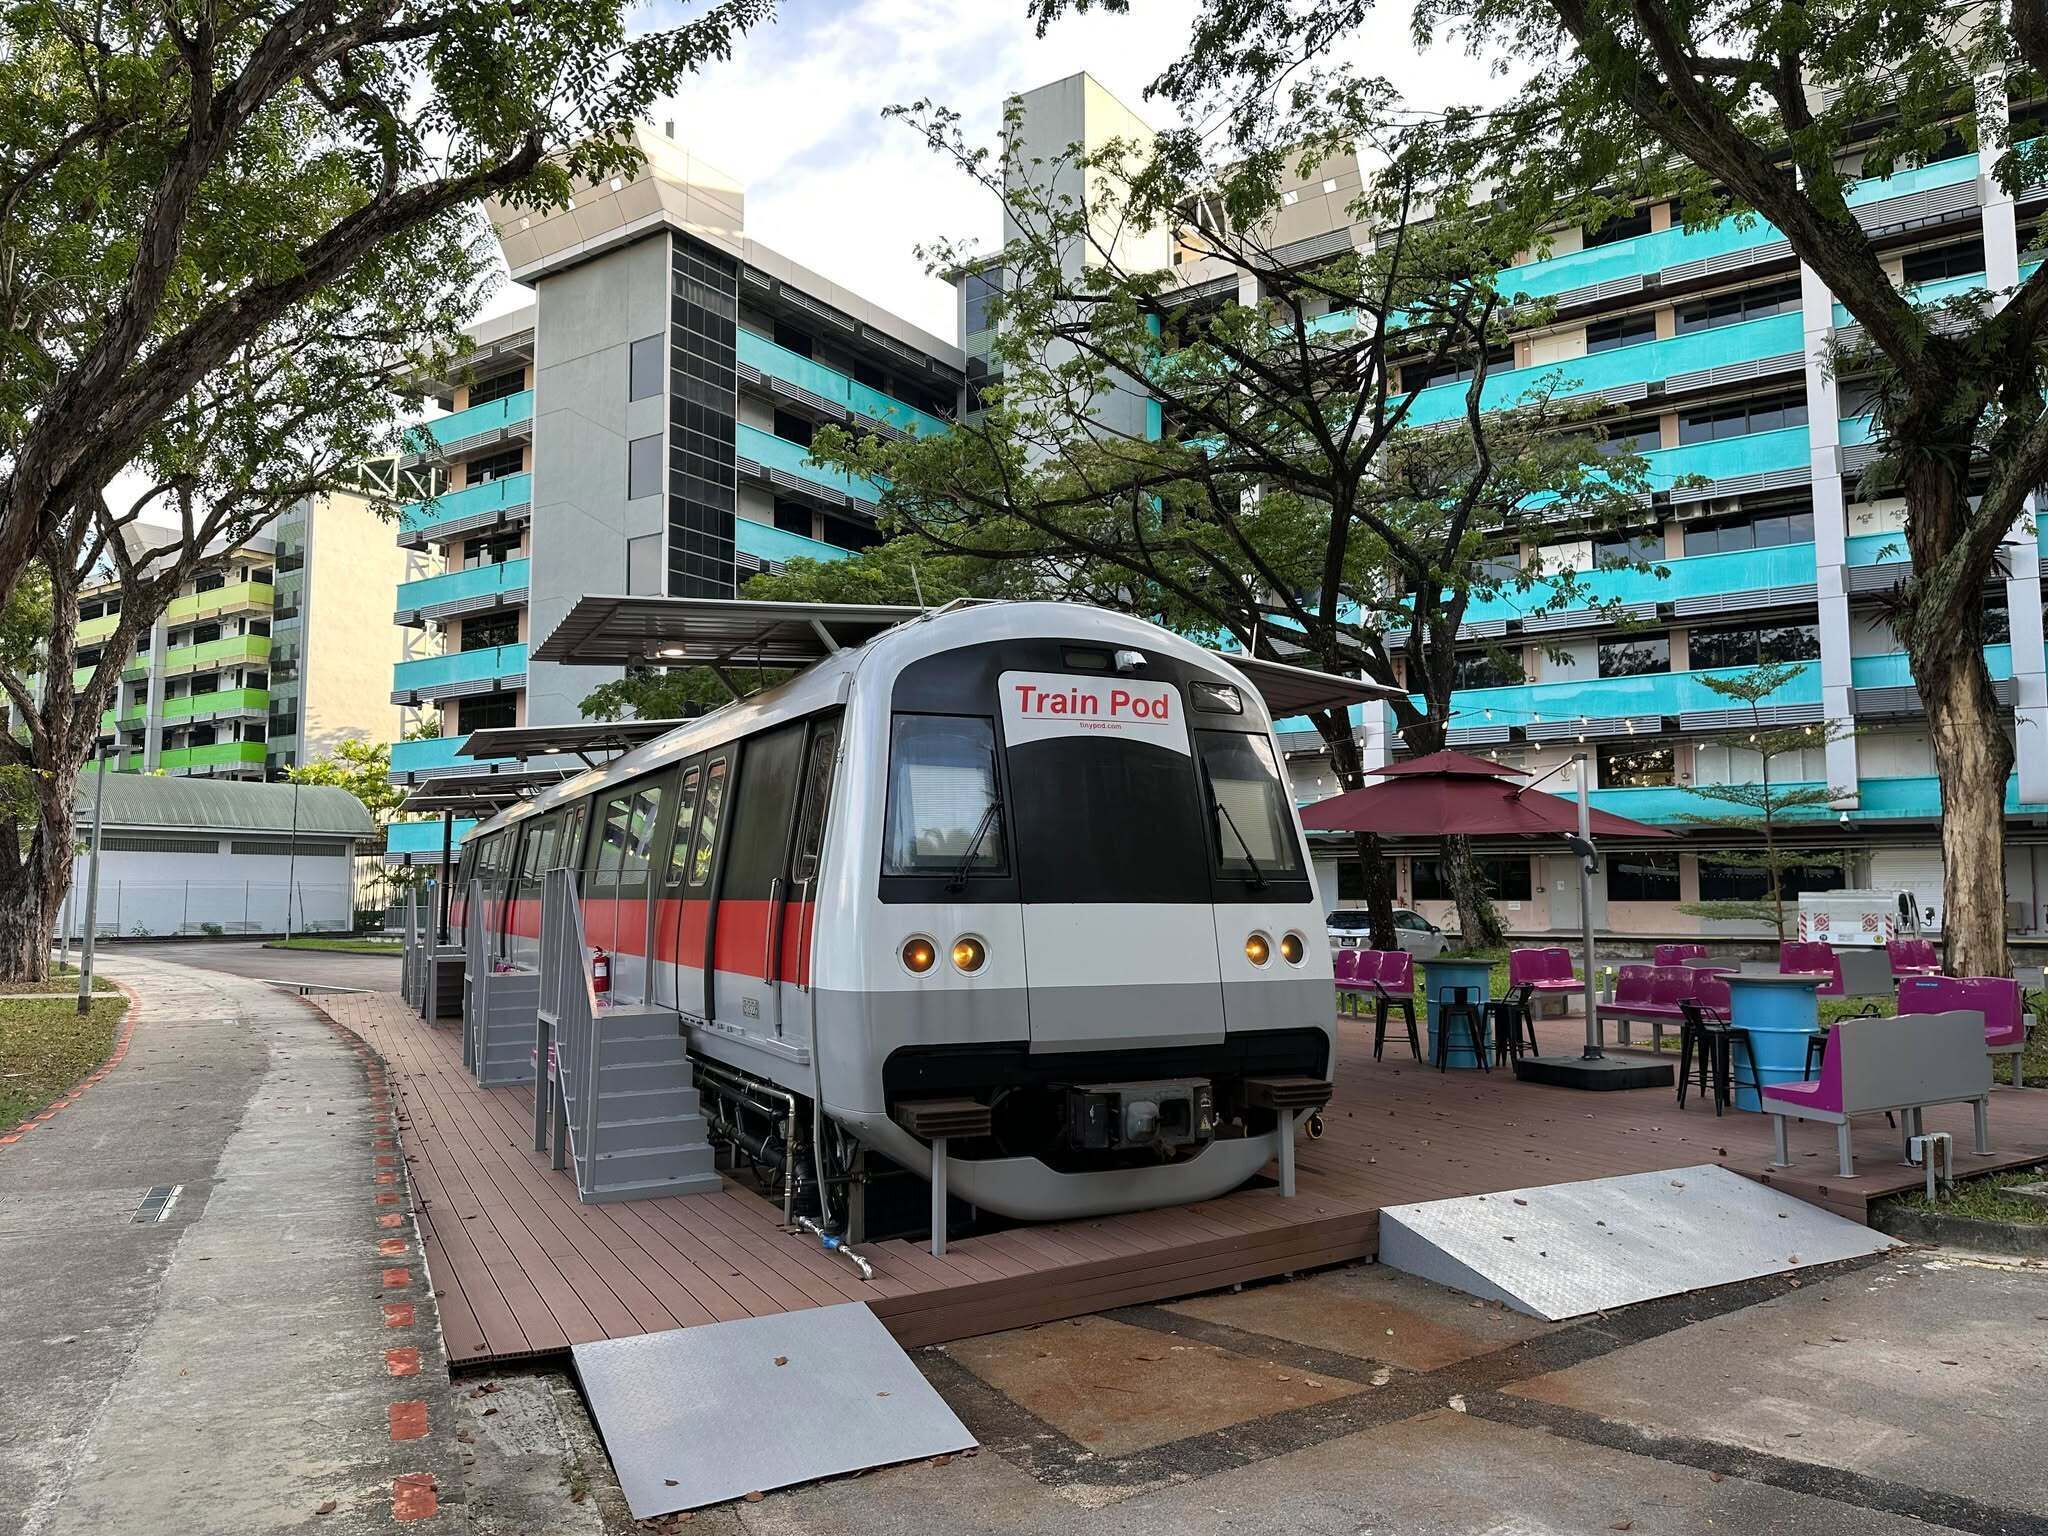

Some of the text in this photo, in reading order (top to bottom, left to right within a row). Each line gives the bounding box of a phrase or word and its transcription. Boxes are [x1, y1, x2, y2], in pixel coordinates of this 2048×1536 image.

[1015, 686, 1169, 719] Train Pod
[1079, 721, 1122, 730] tinypod.com
